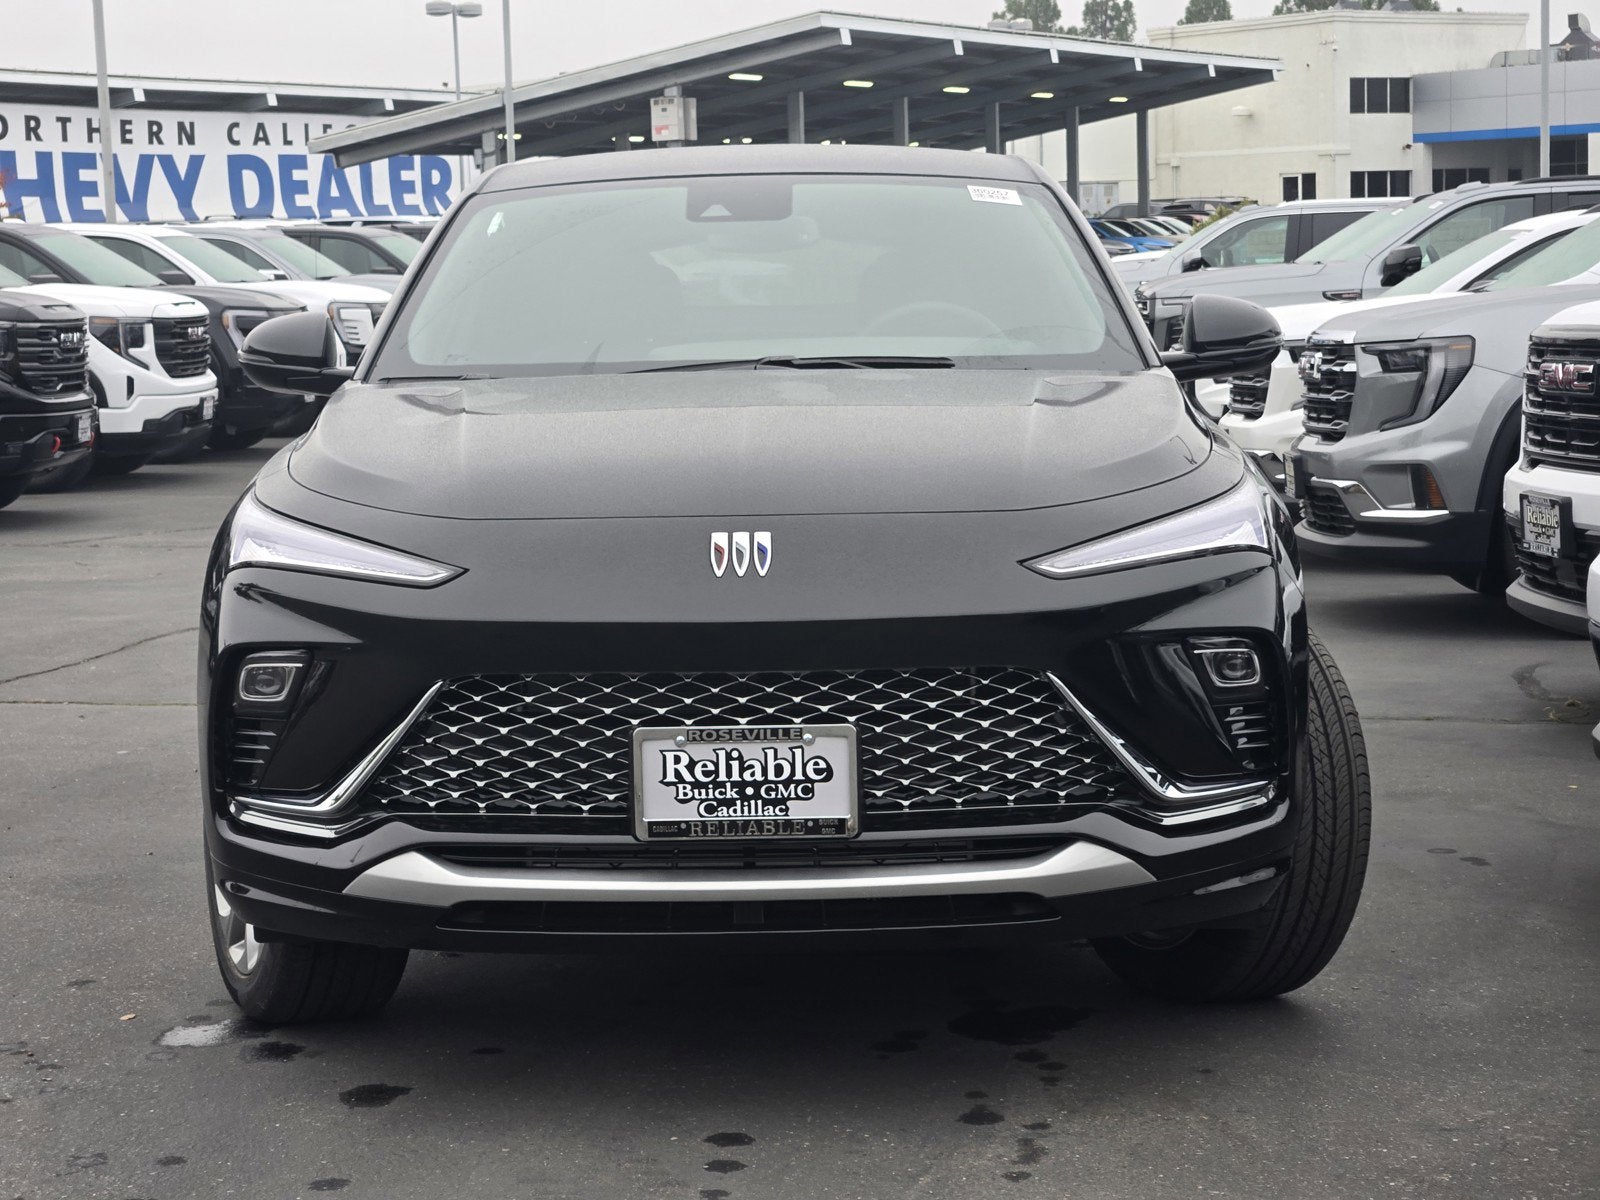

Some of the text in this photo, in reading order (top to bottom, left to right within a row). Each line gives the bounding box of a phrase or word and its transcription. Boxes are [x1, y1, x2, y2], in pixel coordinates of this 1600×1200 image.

[227, 154, 453, 219] DEALER
[1538, 362, 1594, 390] GMC
[1526, 505, 1559, 529] Reliable
[688, 728, 802, 742] ROSEVILLE
[661, 745, 830, 784] Reliable
[676, 782, 813, 800] Buick GMC
[698, 800, 787, 818] Cadillac
[689, 820, 806, 837] RELIABLE
